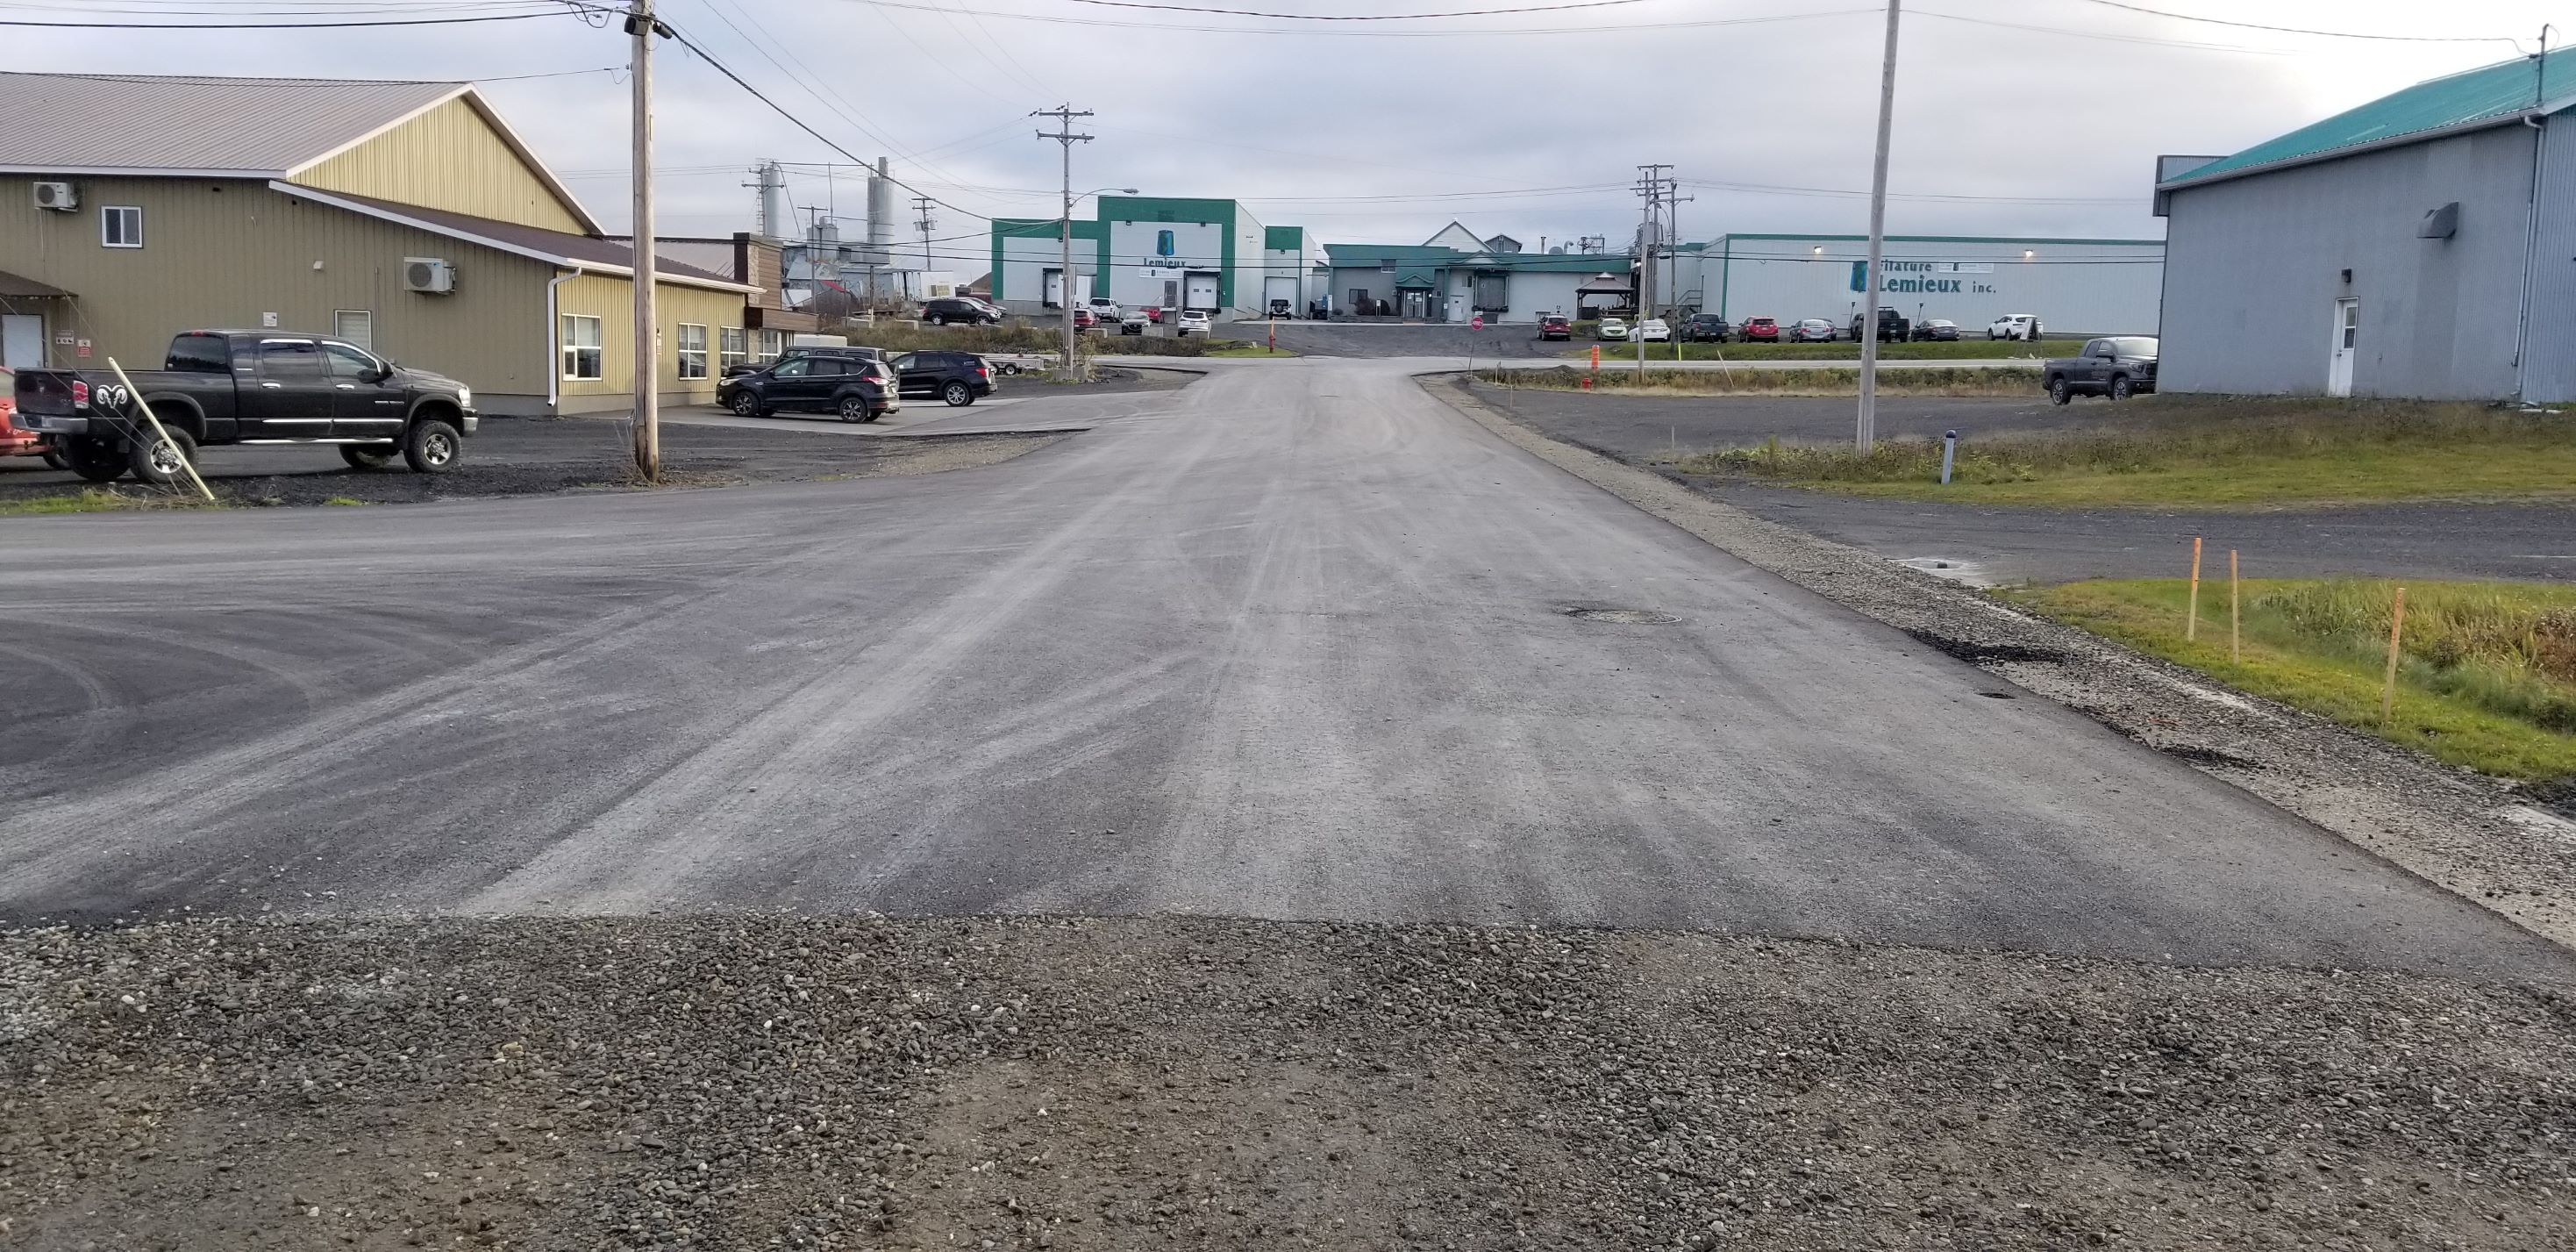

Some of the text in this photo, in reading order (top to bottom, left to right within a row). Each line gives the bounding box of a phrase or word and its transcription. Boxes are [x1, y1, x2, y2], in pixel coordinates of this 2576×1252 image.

[1143, 257, 1186, 268] Lemieux
[1880, 259, 1932, 271] ilature
[1880, 275, 1997, 293] Lemieux inc.
